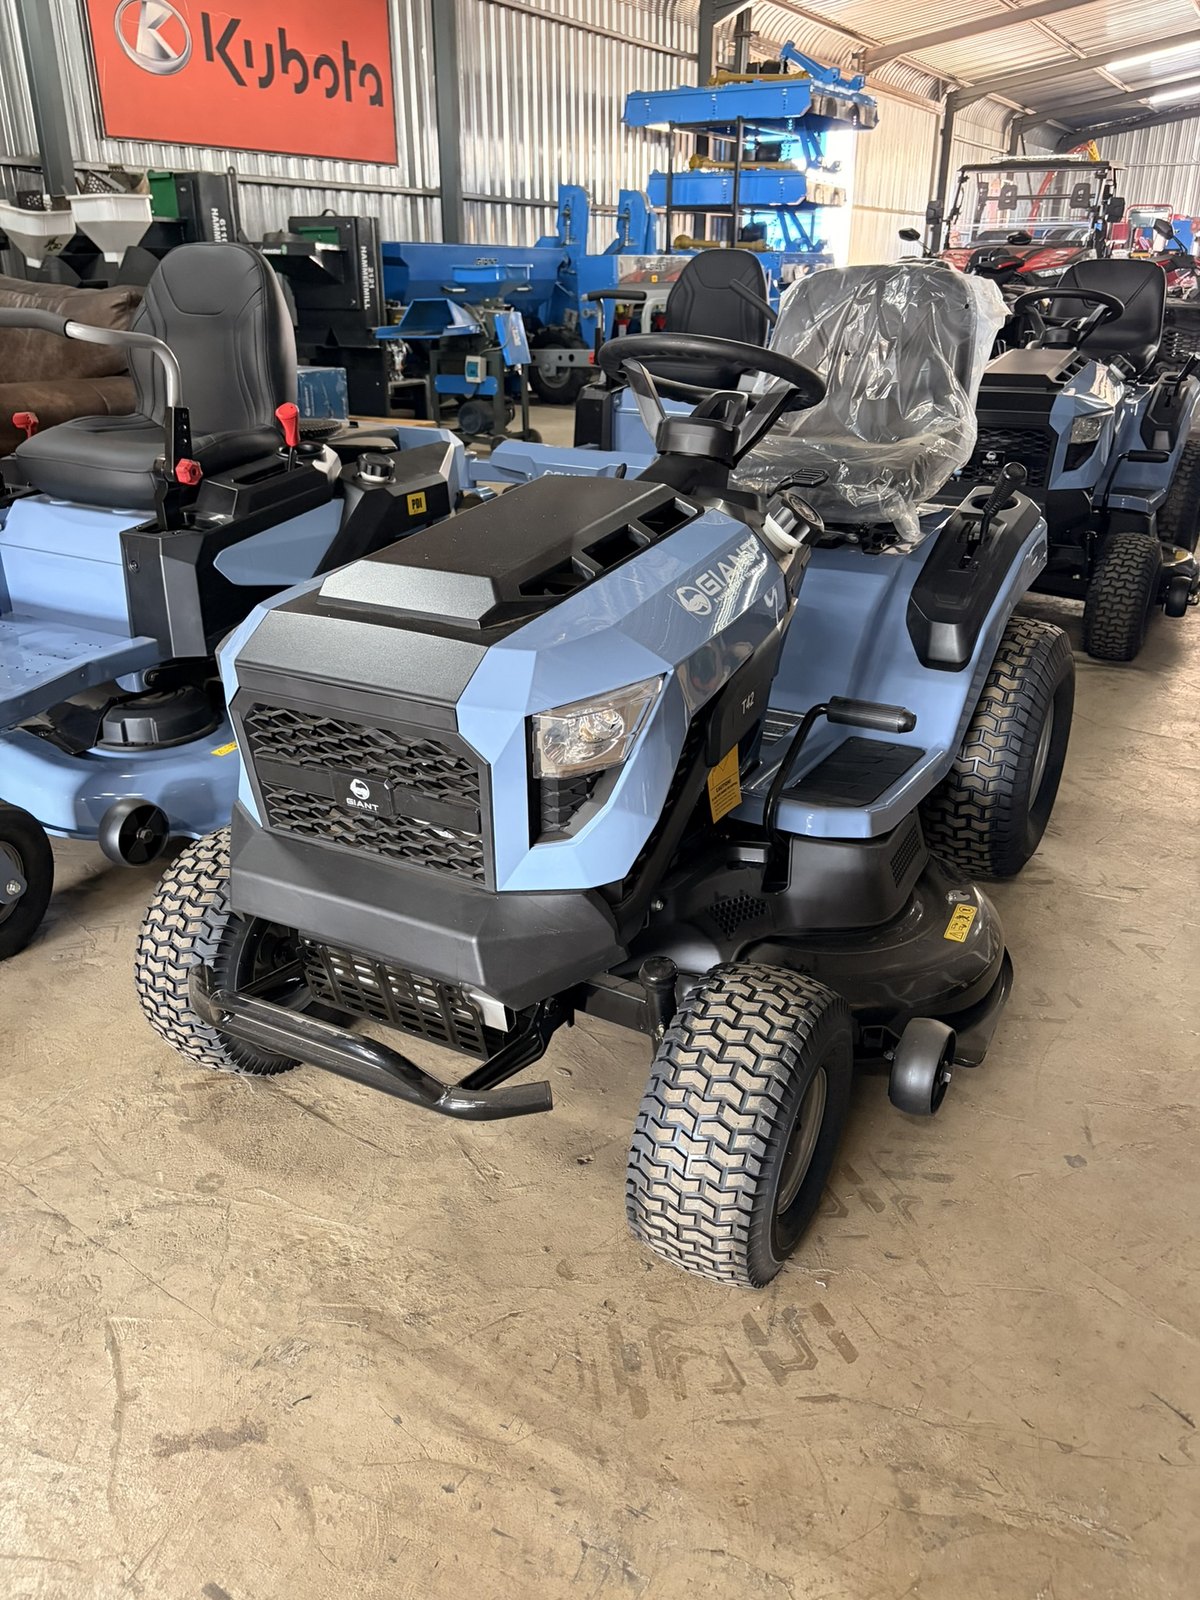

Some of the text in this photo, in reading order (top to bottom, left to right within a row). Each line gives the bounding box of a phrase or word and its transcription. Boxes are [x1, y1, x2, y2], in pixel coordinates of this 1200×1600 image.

[201, 11, 384, 107] Kubota
[360, 245, 371, 311] HAMMERMILL
[696, 537, 760, 596] GIANT
[741, 691, 755, 714] T42
[346, 797, 379, 811] GIANT
